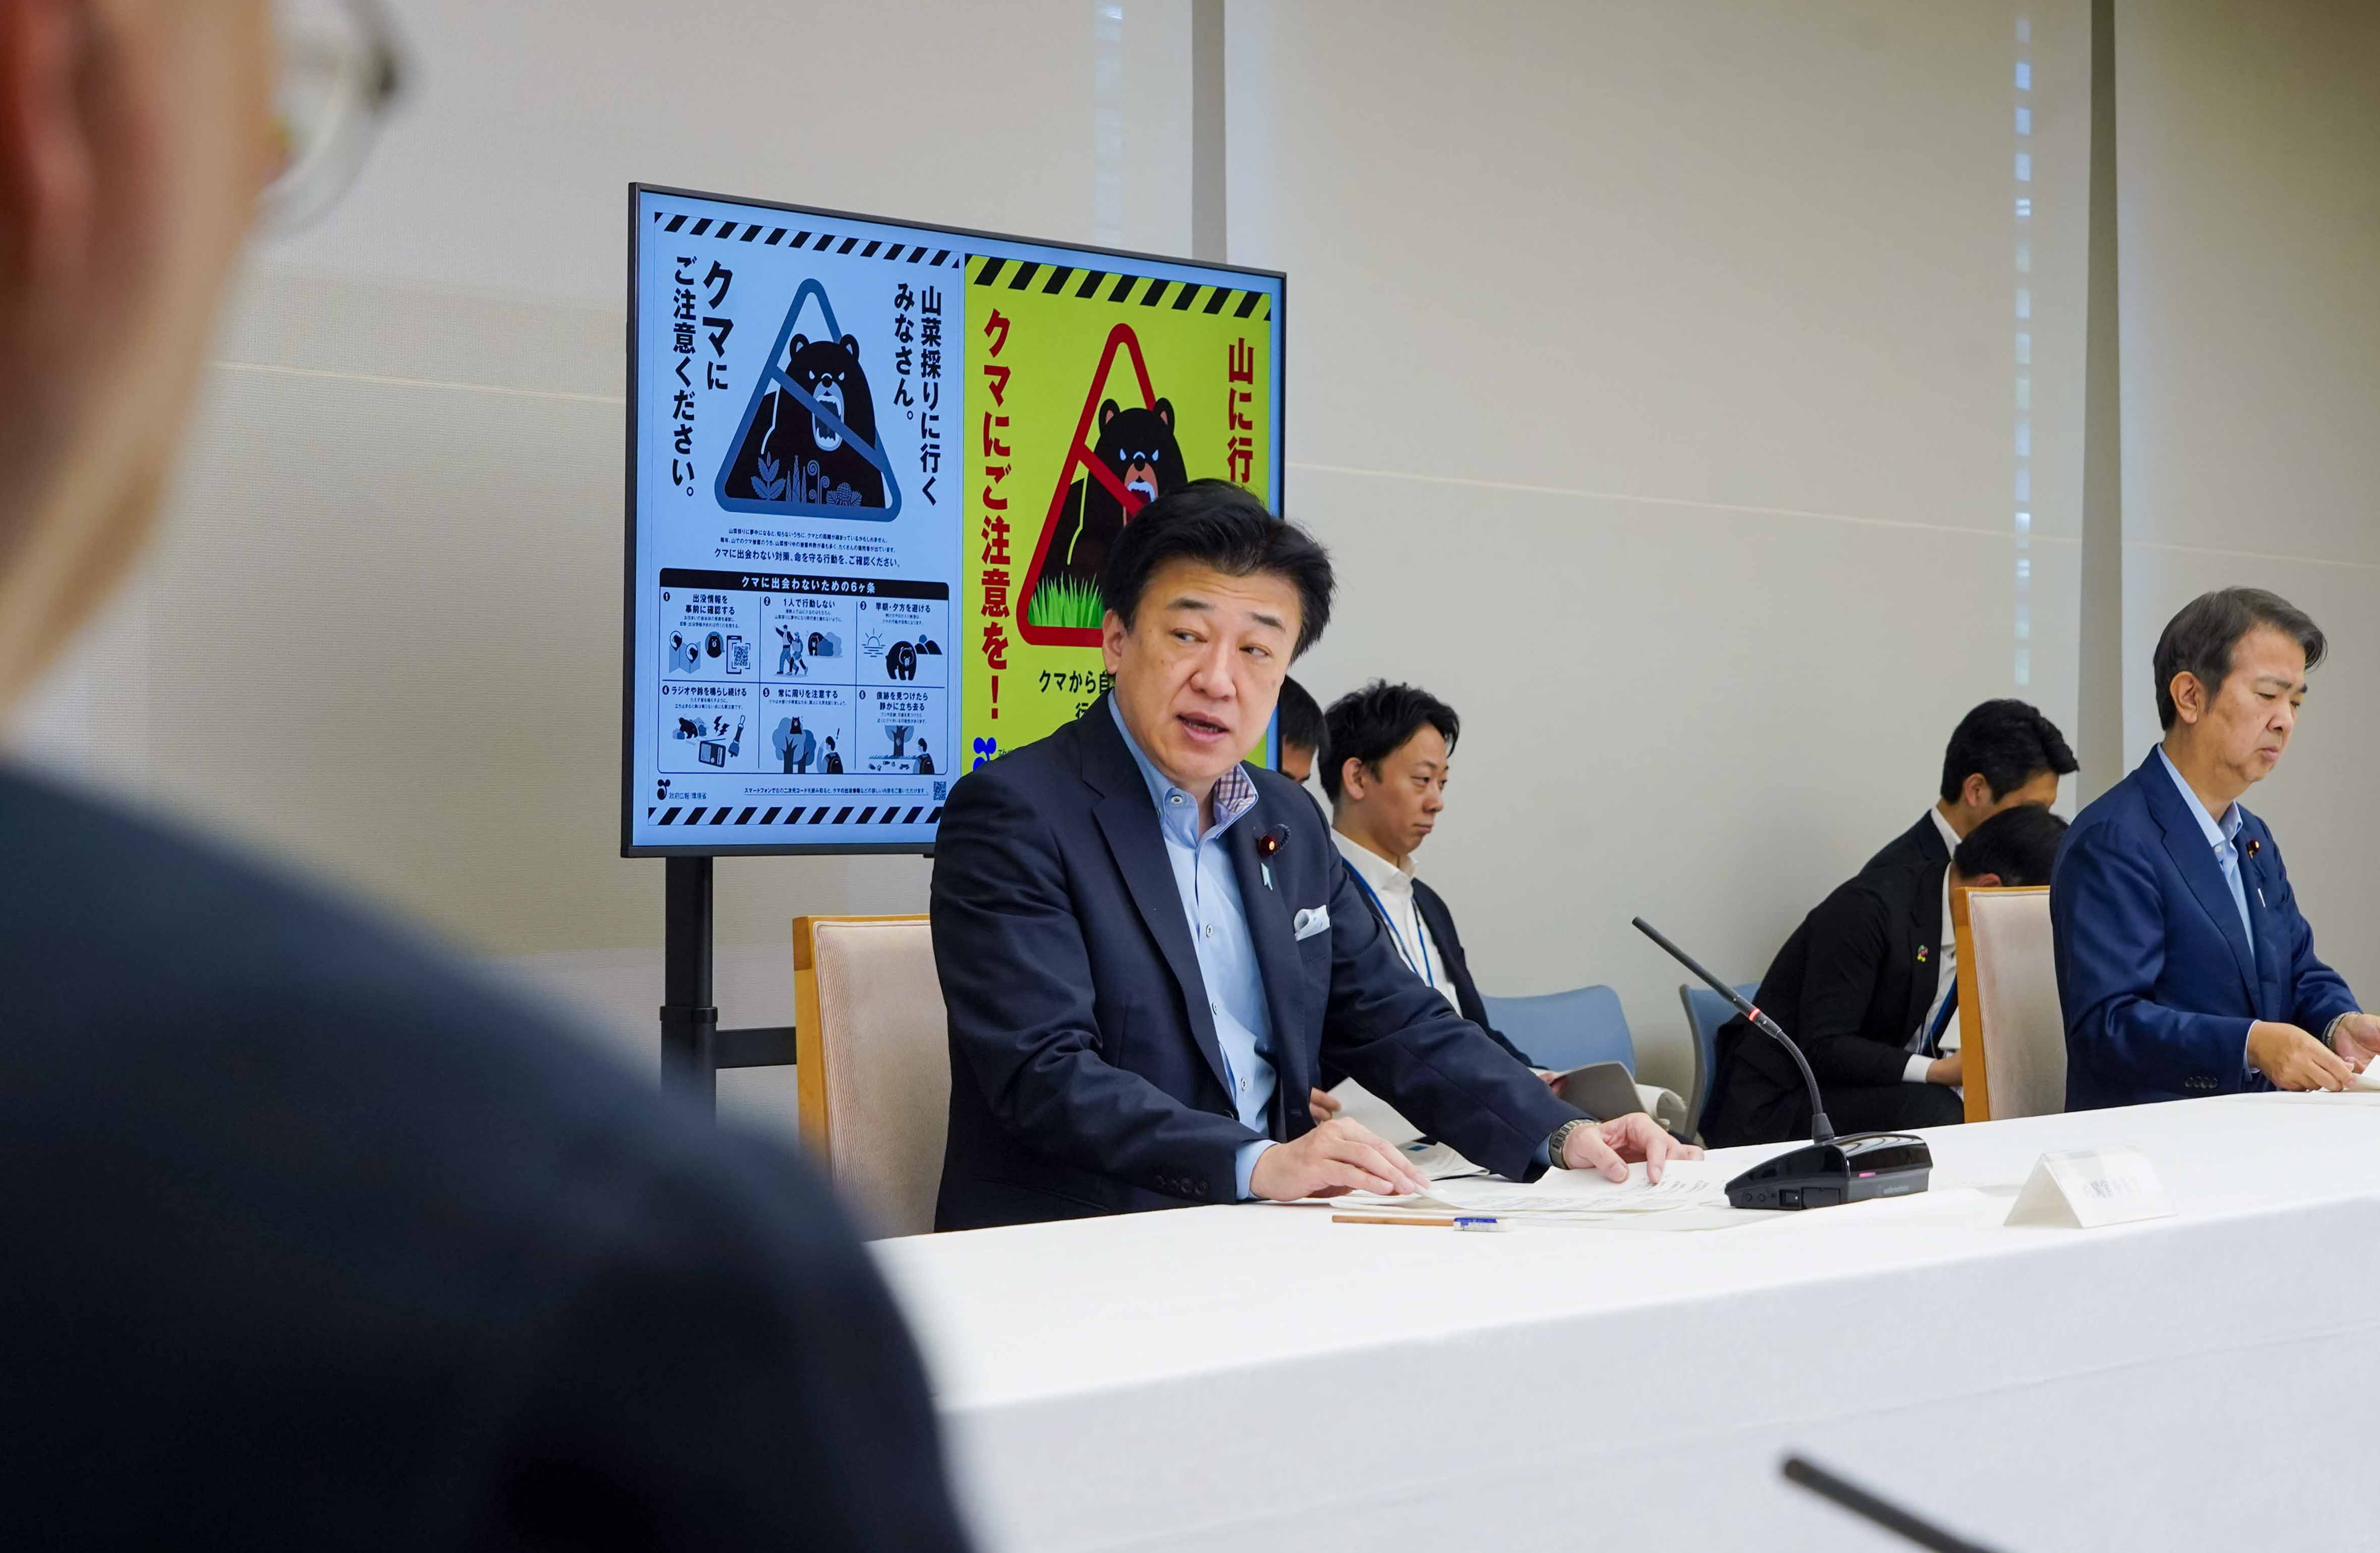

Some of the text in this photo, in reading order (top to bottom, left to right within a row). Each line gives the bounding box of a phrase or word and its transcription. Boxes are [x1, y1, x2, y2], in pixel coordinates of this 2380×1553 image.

[702, 260, 734, 391] クマに
[894, 283, 915, 420] みなさん。
[672, 256, 697, 497] ご注意ください。
[920, 286, 942, 506] 山菜採りに行く
[981, 308, 1012, 719] クマにご注意を！
[715, 547, 900, 568] クマに出会わない対策、命を守る行動を、ご確認ください。
[693, 594, 728, 604] 出没情報を
[784, 598, 835, 608] 1人で行動しない
[686, 604, 735, 615] 事前に確認する
[672, 686, 747, 697] ラジオや鈴を鳴らし続ける
[778, 689, 838, 699] 常に周りを注意する
[879, 702, 925, 711] 静かに立ち去る
